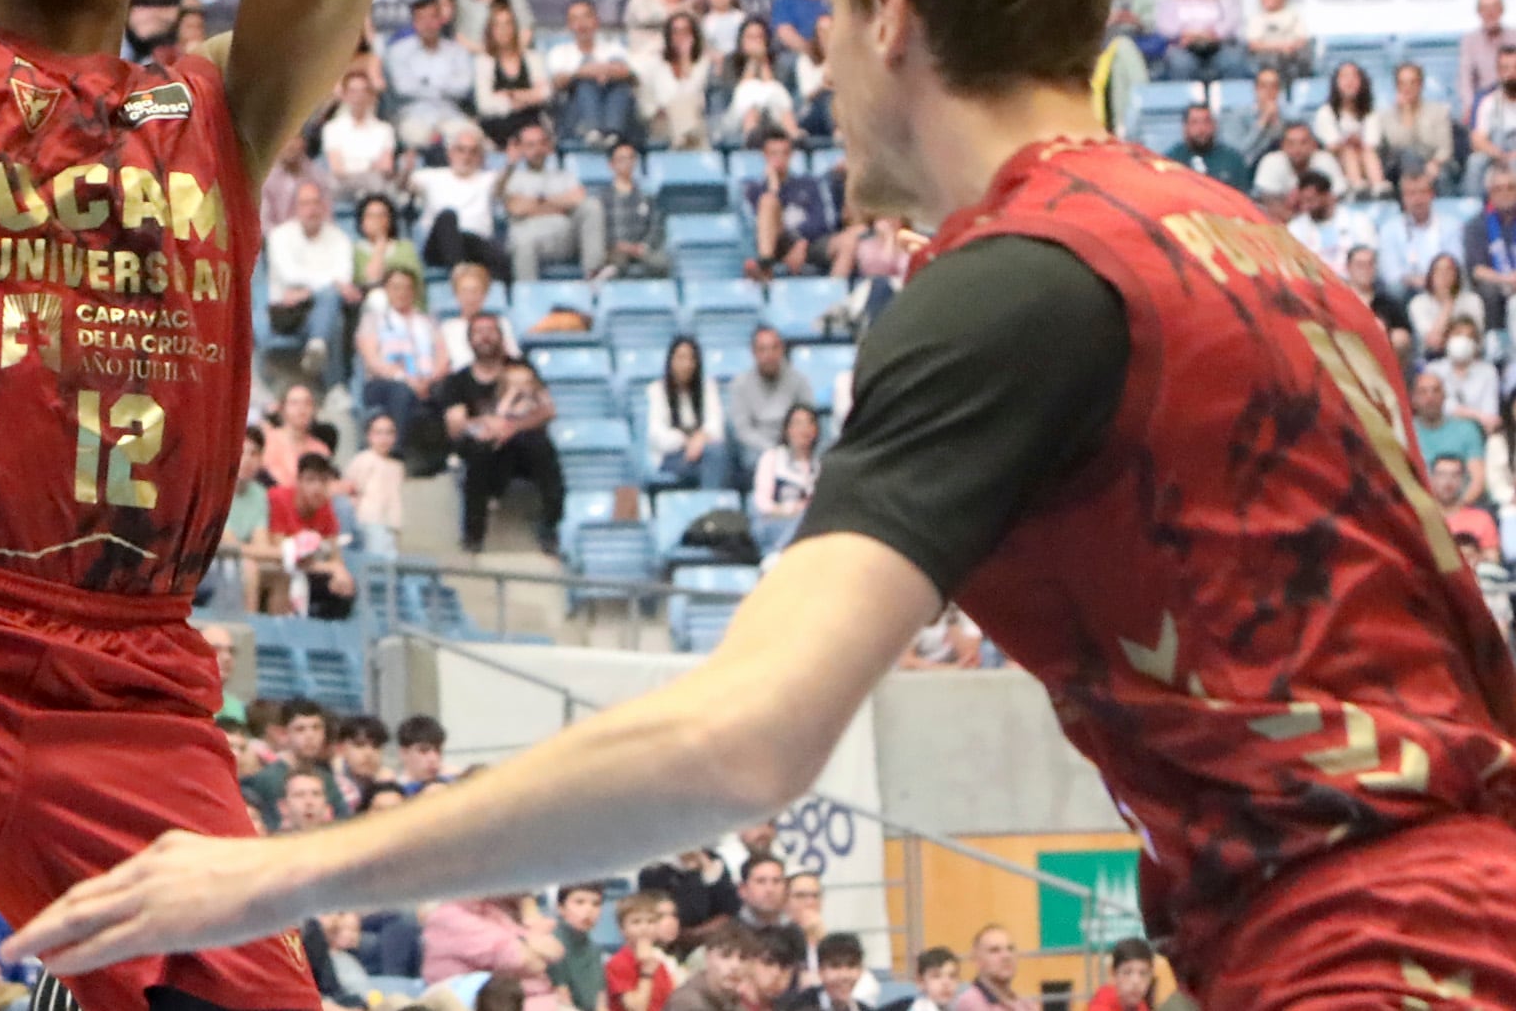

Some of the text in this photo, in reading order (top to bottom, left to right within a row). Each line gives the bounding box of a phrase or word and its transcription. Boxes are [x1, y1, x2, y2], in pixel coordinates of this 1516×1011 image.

[75, 303, 196, 330] CARAVAC
[77, 328, 106, 348] DE
[110, 331, 137, 351] LA
[73, 390, 166, 510] 12
